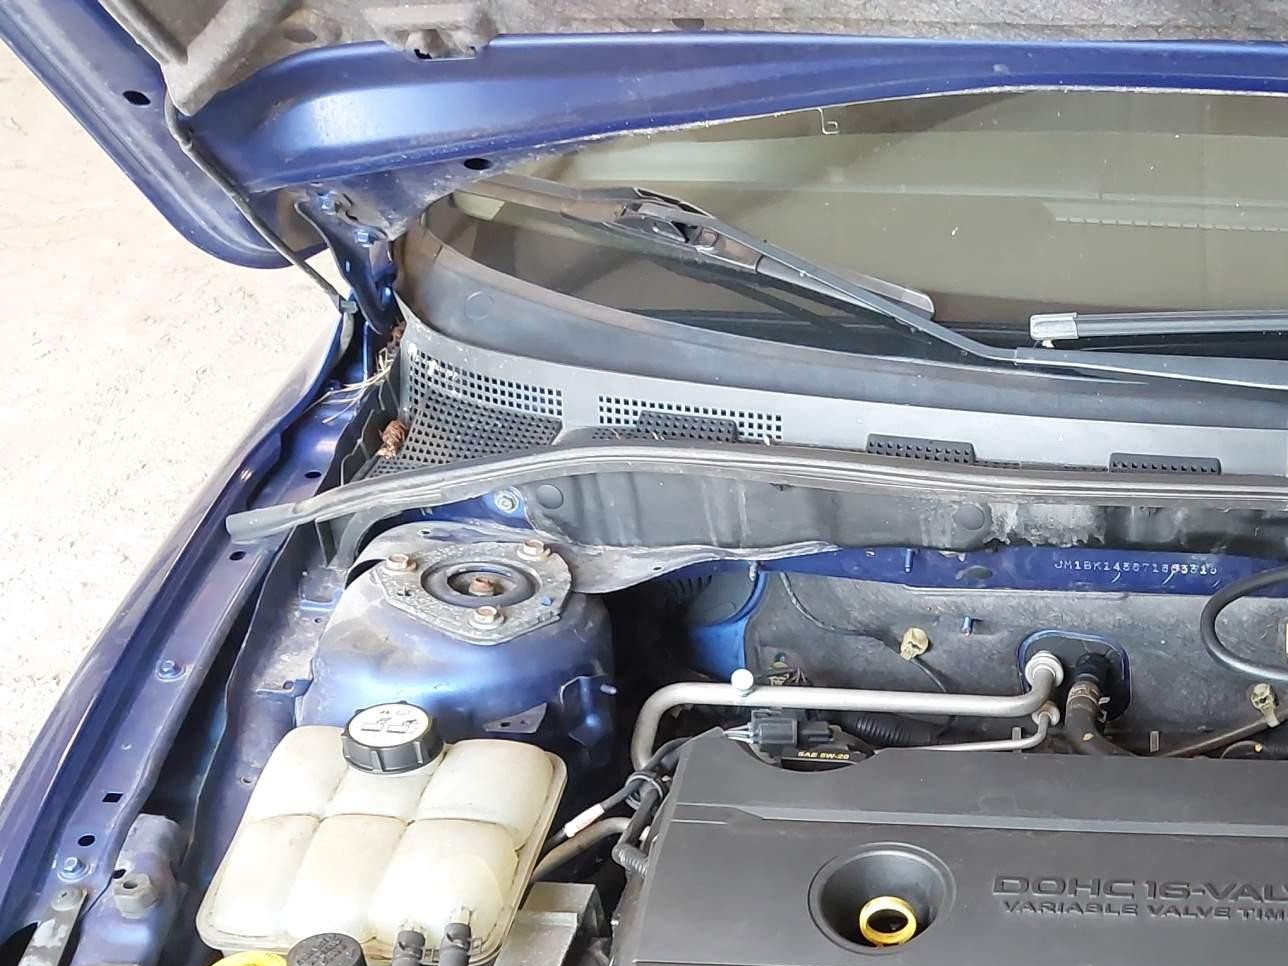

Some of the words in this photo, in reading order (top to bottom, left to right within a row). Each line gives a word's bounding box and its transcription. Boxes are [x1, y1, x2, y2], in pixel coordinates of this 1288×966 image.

[819, 752, 850, 760] 5W-20
[992, 876, 1136, 899] DOHC
[1004, 901, 1138, 917] VARIABLE
[1147, 904, 1231, 919] VALVE
